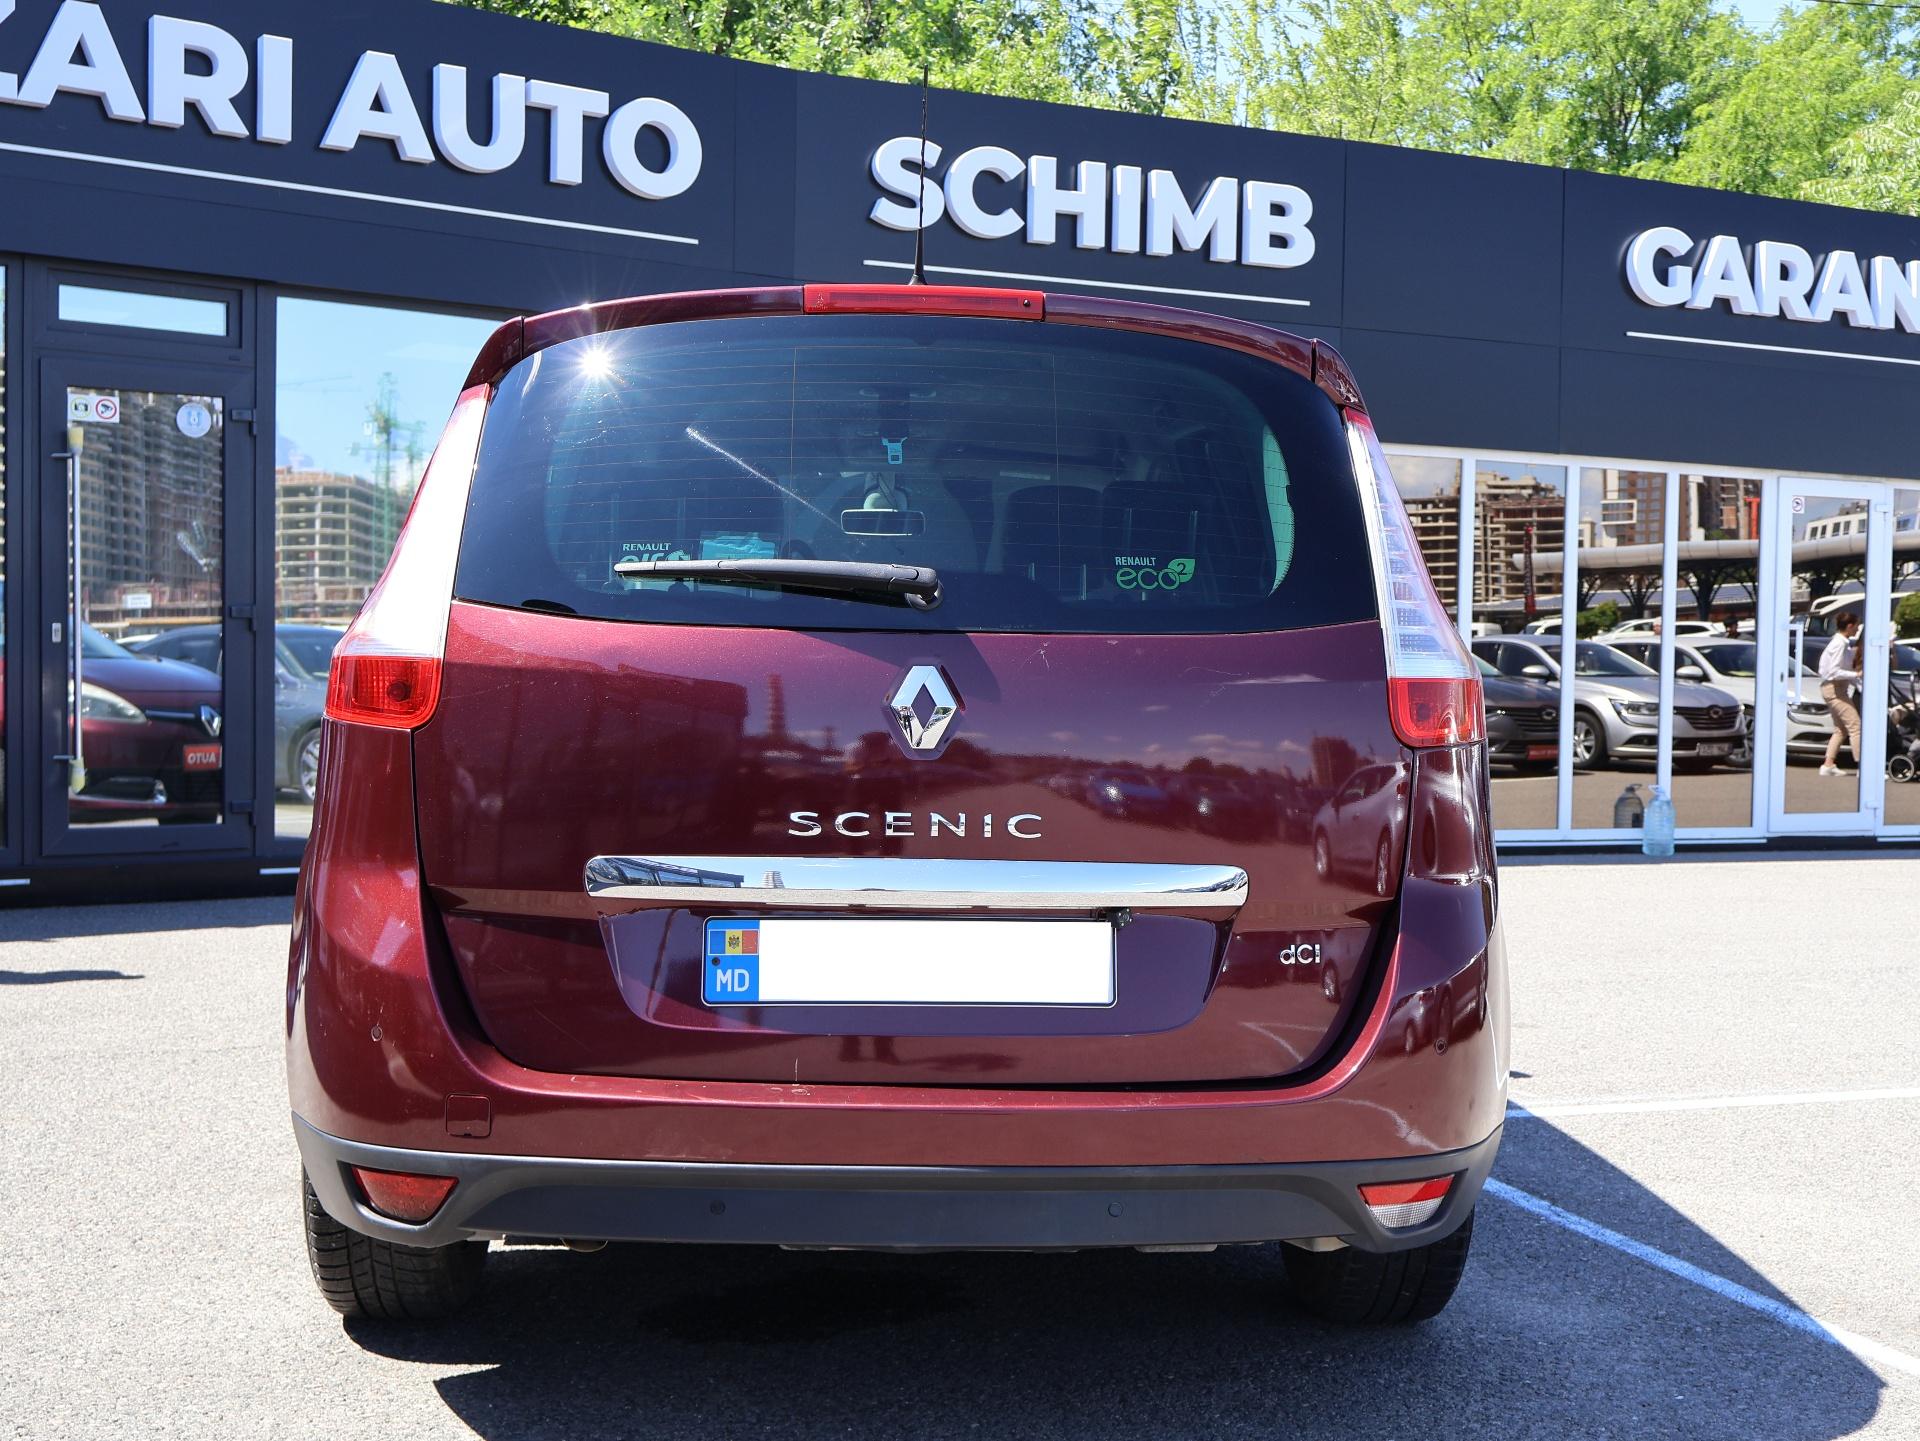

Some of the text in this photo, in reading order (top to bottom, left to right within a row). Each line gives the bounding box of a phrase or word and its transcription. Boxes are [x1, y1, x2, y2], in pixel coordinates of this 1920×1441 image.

[0, 0, 702, 200] ARI AUTO
[869, 136, 1316, 268] SCHIMB
[622, 542, 672, 551] RENAULT
[1115, 556, 1156, 566] RENAULT
[788, 811, 1042, 838] SCENIC
[716, 968, 750, 992] MD
